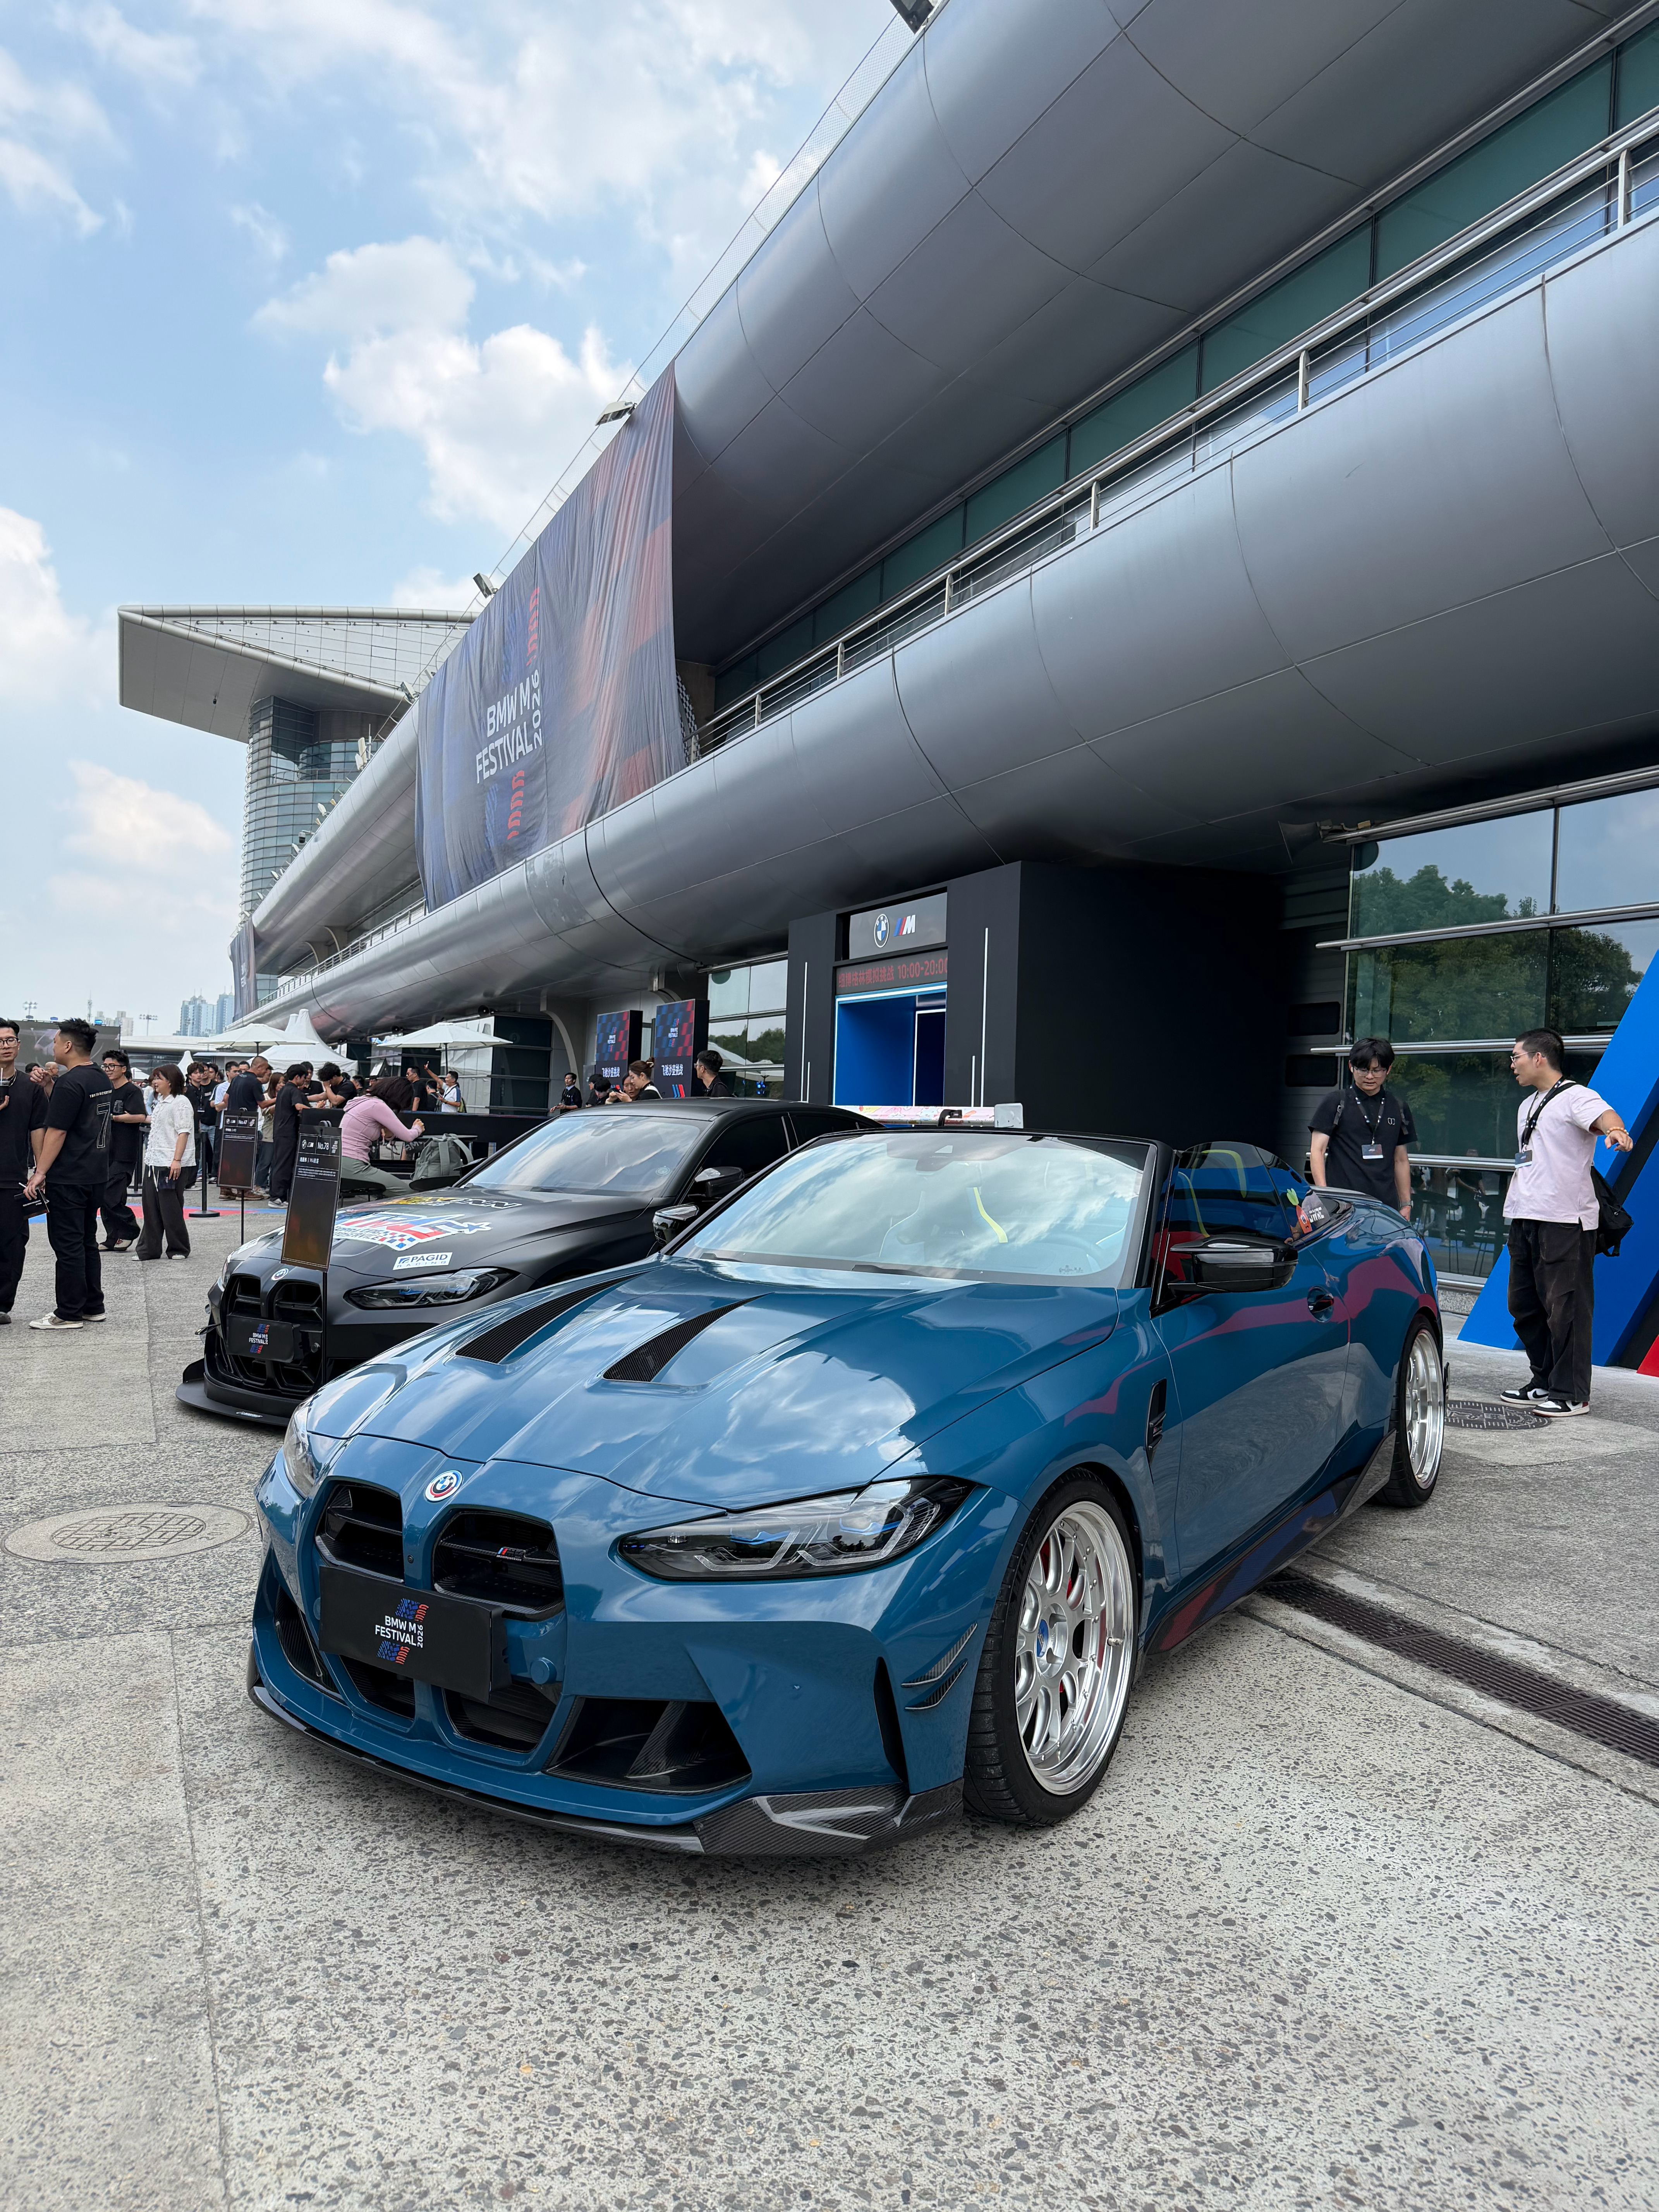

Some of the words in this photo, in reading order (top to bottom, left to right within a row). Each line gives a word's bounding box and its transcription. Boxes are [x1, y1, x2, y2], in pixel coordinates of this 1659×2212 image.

[487, 687, 517, 738] BMW
[520, 677, 530, 715] M
[532, 669, 542, 749] 2026
[476, 721, 533, 784] FESTIVAL
[97, 1102, 110, 1149] 7
[318, 1142, 329, 1150] No.78
[410, 1254, 448, 1262] PAGID
[375, 1625, 416, 1646] FESTIVAL
[385, 1615, 407, 1630] BMW
[409, 1622, 416, 1633] M
